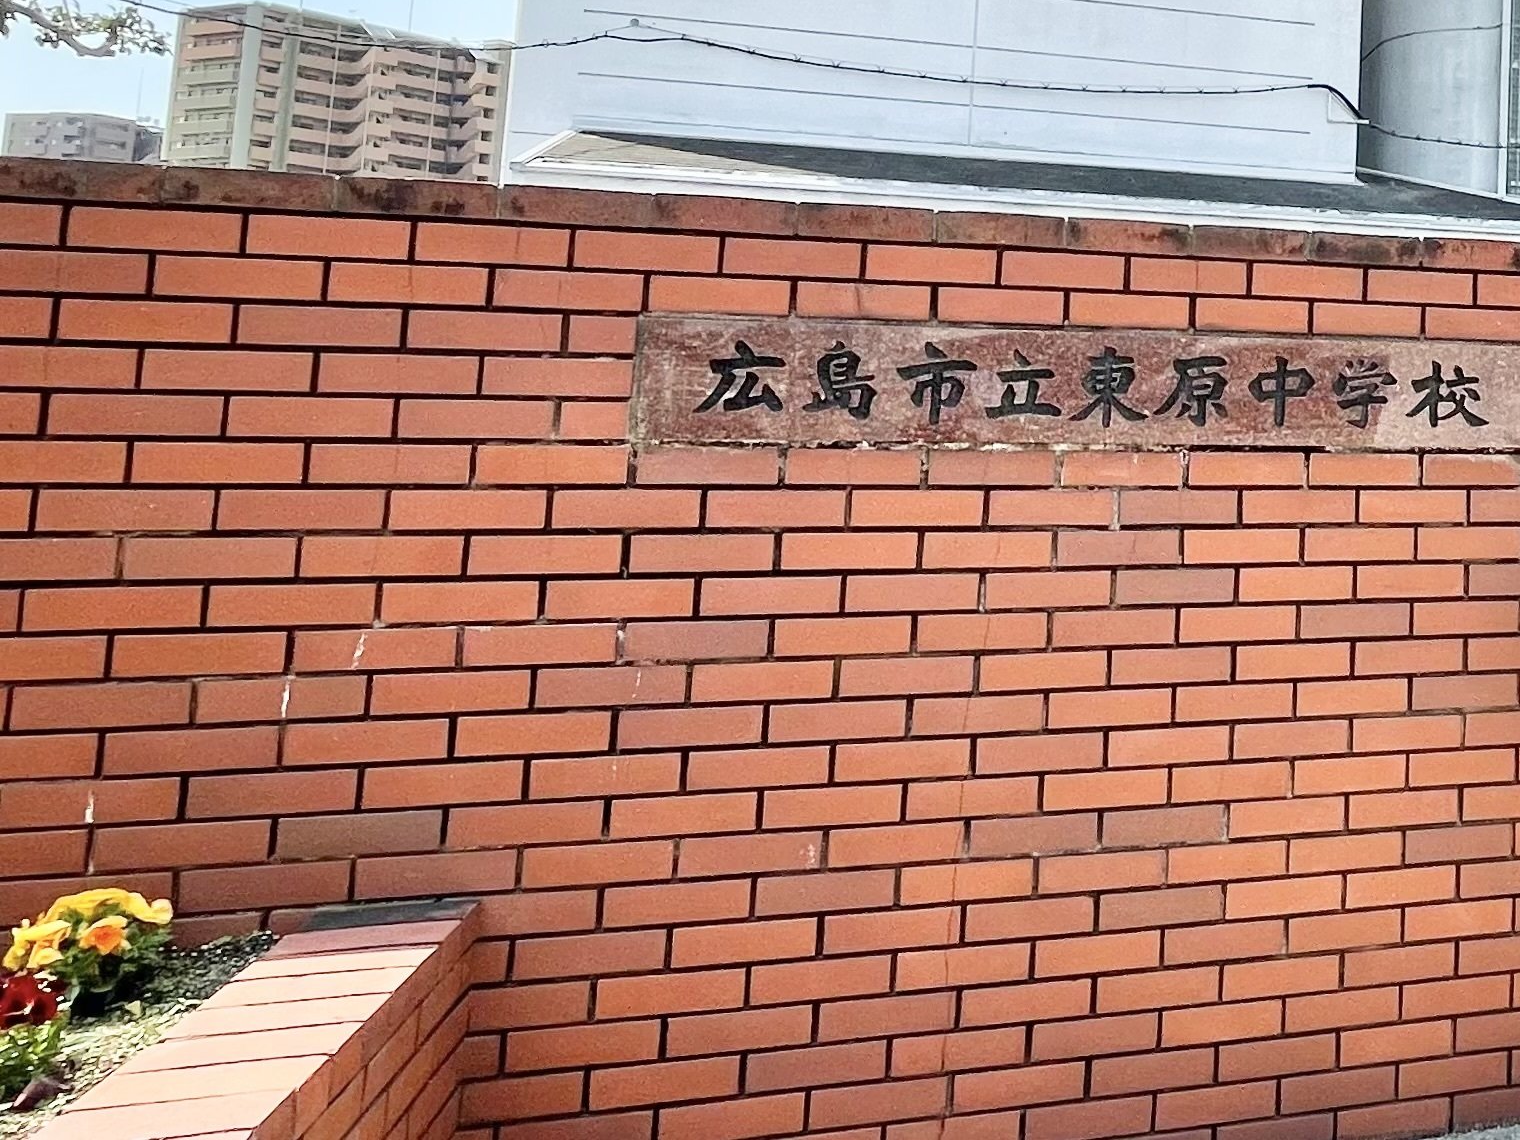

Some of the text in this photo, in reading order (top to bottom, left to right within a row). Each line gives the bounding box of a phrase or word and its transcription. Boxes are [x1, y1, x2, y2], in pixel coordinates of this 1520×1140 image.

[694, 341, 1491, 429] 広島市立東原中学校
